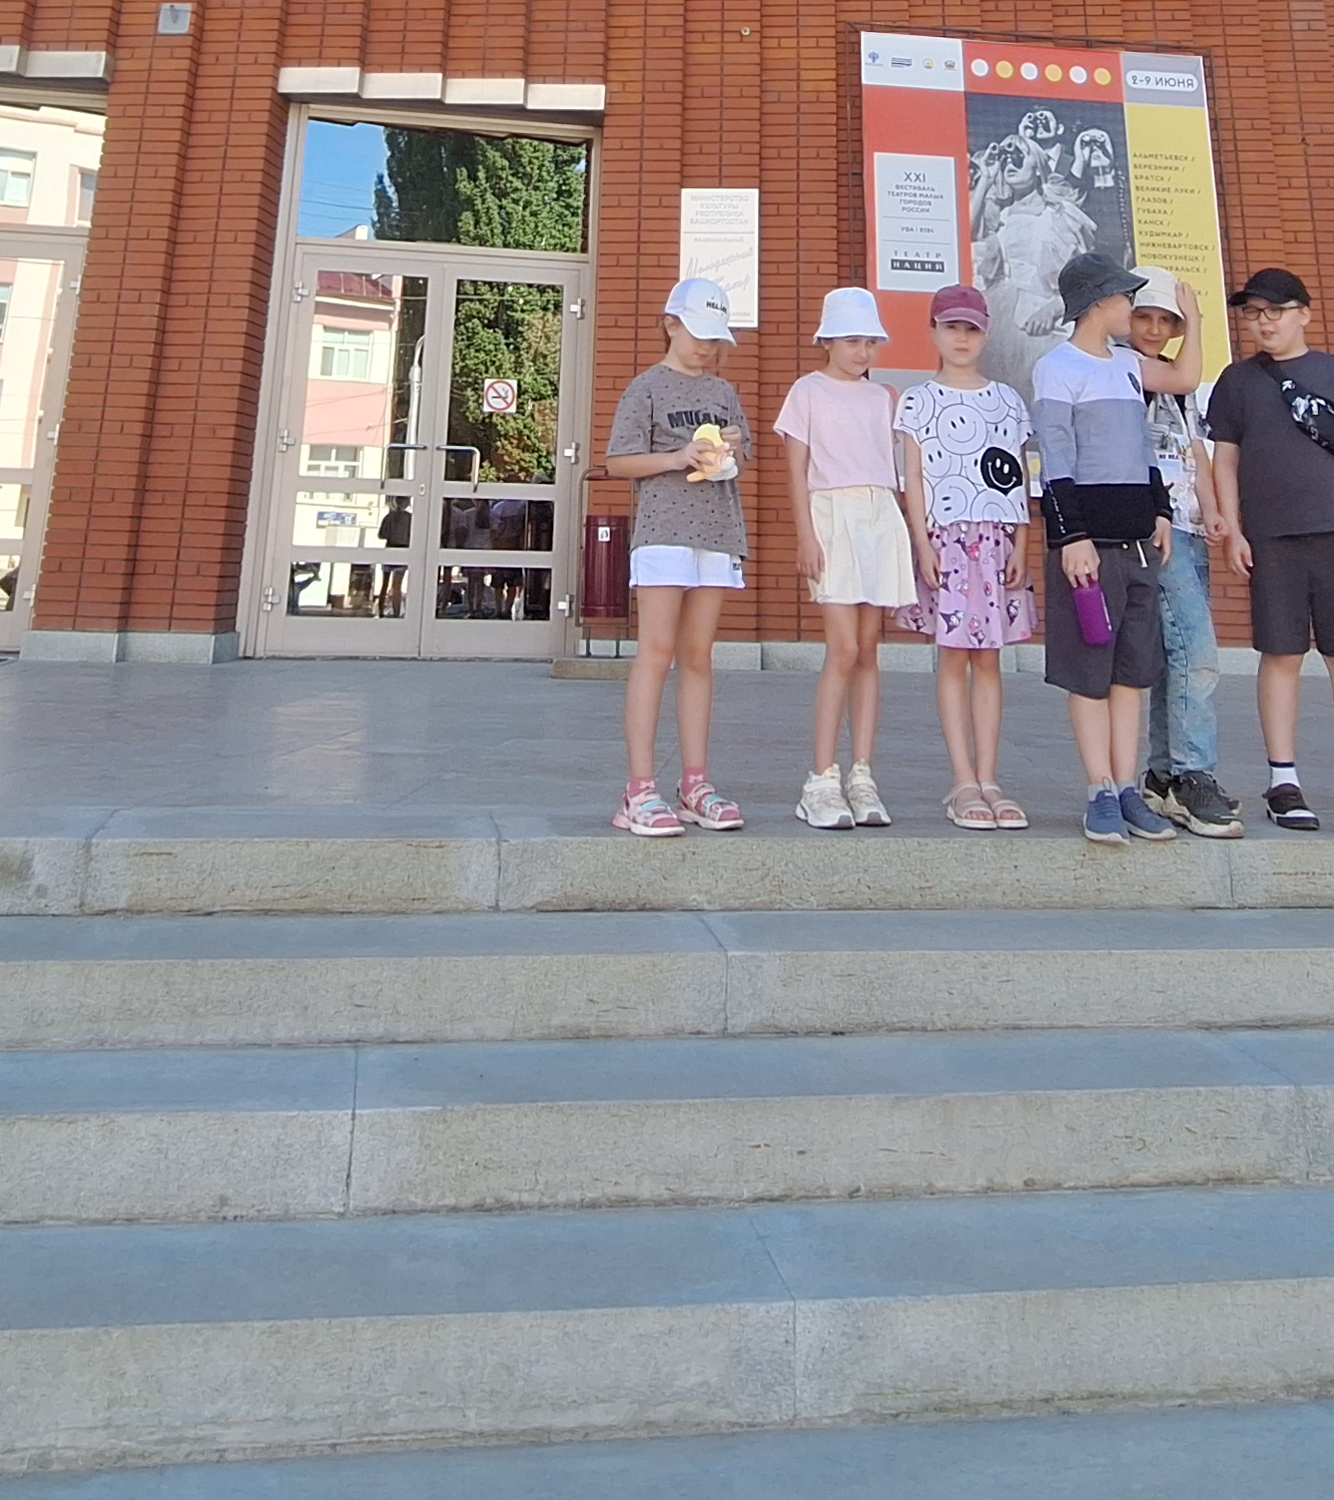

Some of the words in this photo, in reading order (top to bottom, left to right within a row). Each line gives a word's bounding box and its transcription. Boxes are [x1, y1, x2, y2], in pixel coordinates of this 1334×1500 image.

[1131, 75, 1152, 86] 2-9
[1155, 77, 1195, 89] ИЮНЯ
[1133, 153, 1189, 162] АЛЬМЕТЬЕВСК
[1133, 164, 1180, 172] БЕРЕЗНИКИ
[895, 184, 936, 192] ФЕСТИВАЛЬ
[1135, 185, 1172, 193] ВЕЛИКИЕ
[887, 191, 918, 199] ТЕАТРОВ
[900, 199, 932, 207] ГОРОДОВ
[1137, 207, 1168, 215] ГУБАХА
[1138, 219, 1165, 227] КАНСК
[1139, 230, 1184, 239] КУДЫМКАР
[1140, 242, 1210, 251] НИЖНЕВАРТОВСК
[894, 250, 942, 259] ТЕАТР
[1141, 253, 1200, 263] НОВОКУЗНЕЦК
